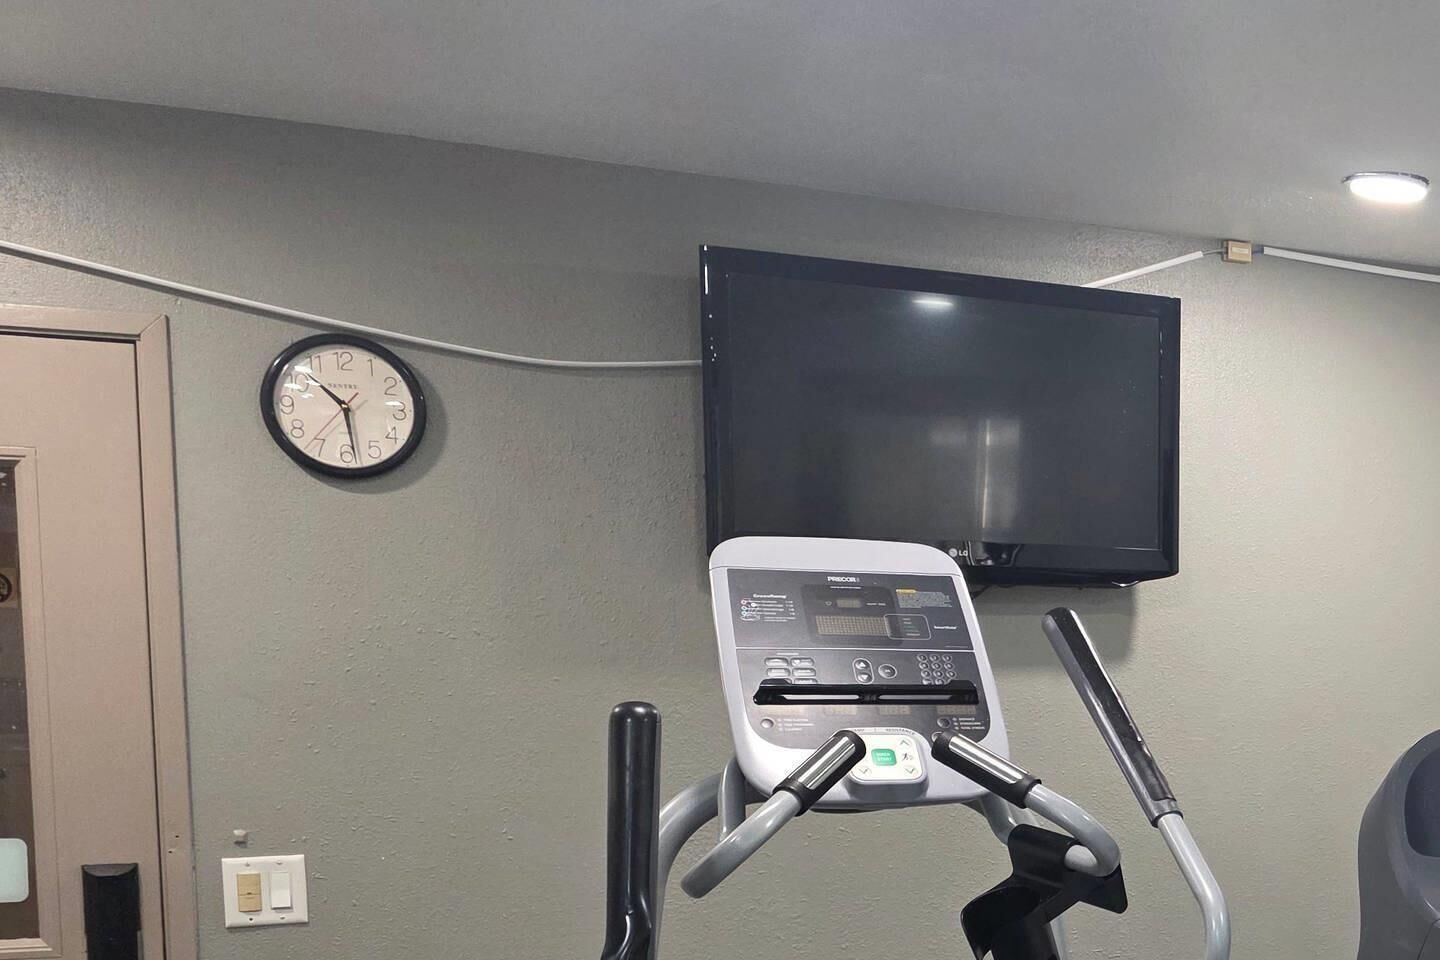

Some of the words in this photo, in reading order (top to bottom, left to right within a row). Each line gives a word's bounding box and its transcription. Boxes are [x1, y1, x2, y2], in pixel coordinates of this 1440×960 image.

[305, 354, 322, 374] 11
[333, 351, 354, 371] 12
[367, 358, 374, 377] 1
[288, 373, 309, 392] 10
[384, 376, 397, 396] 2
[280, 394, 294, 415] 9
[391, 401, 407, 421] 3
[290, 418, 304, 438] 8
[385, 426, 399, 445] 4
[313, 437, 326, 458] 7
[340, 444, 354, 464] 6
[367, 440, 382, 459] 5
